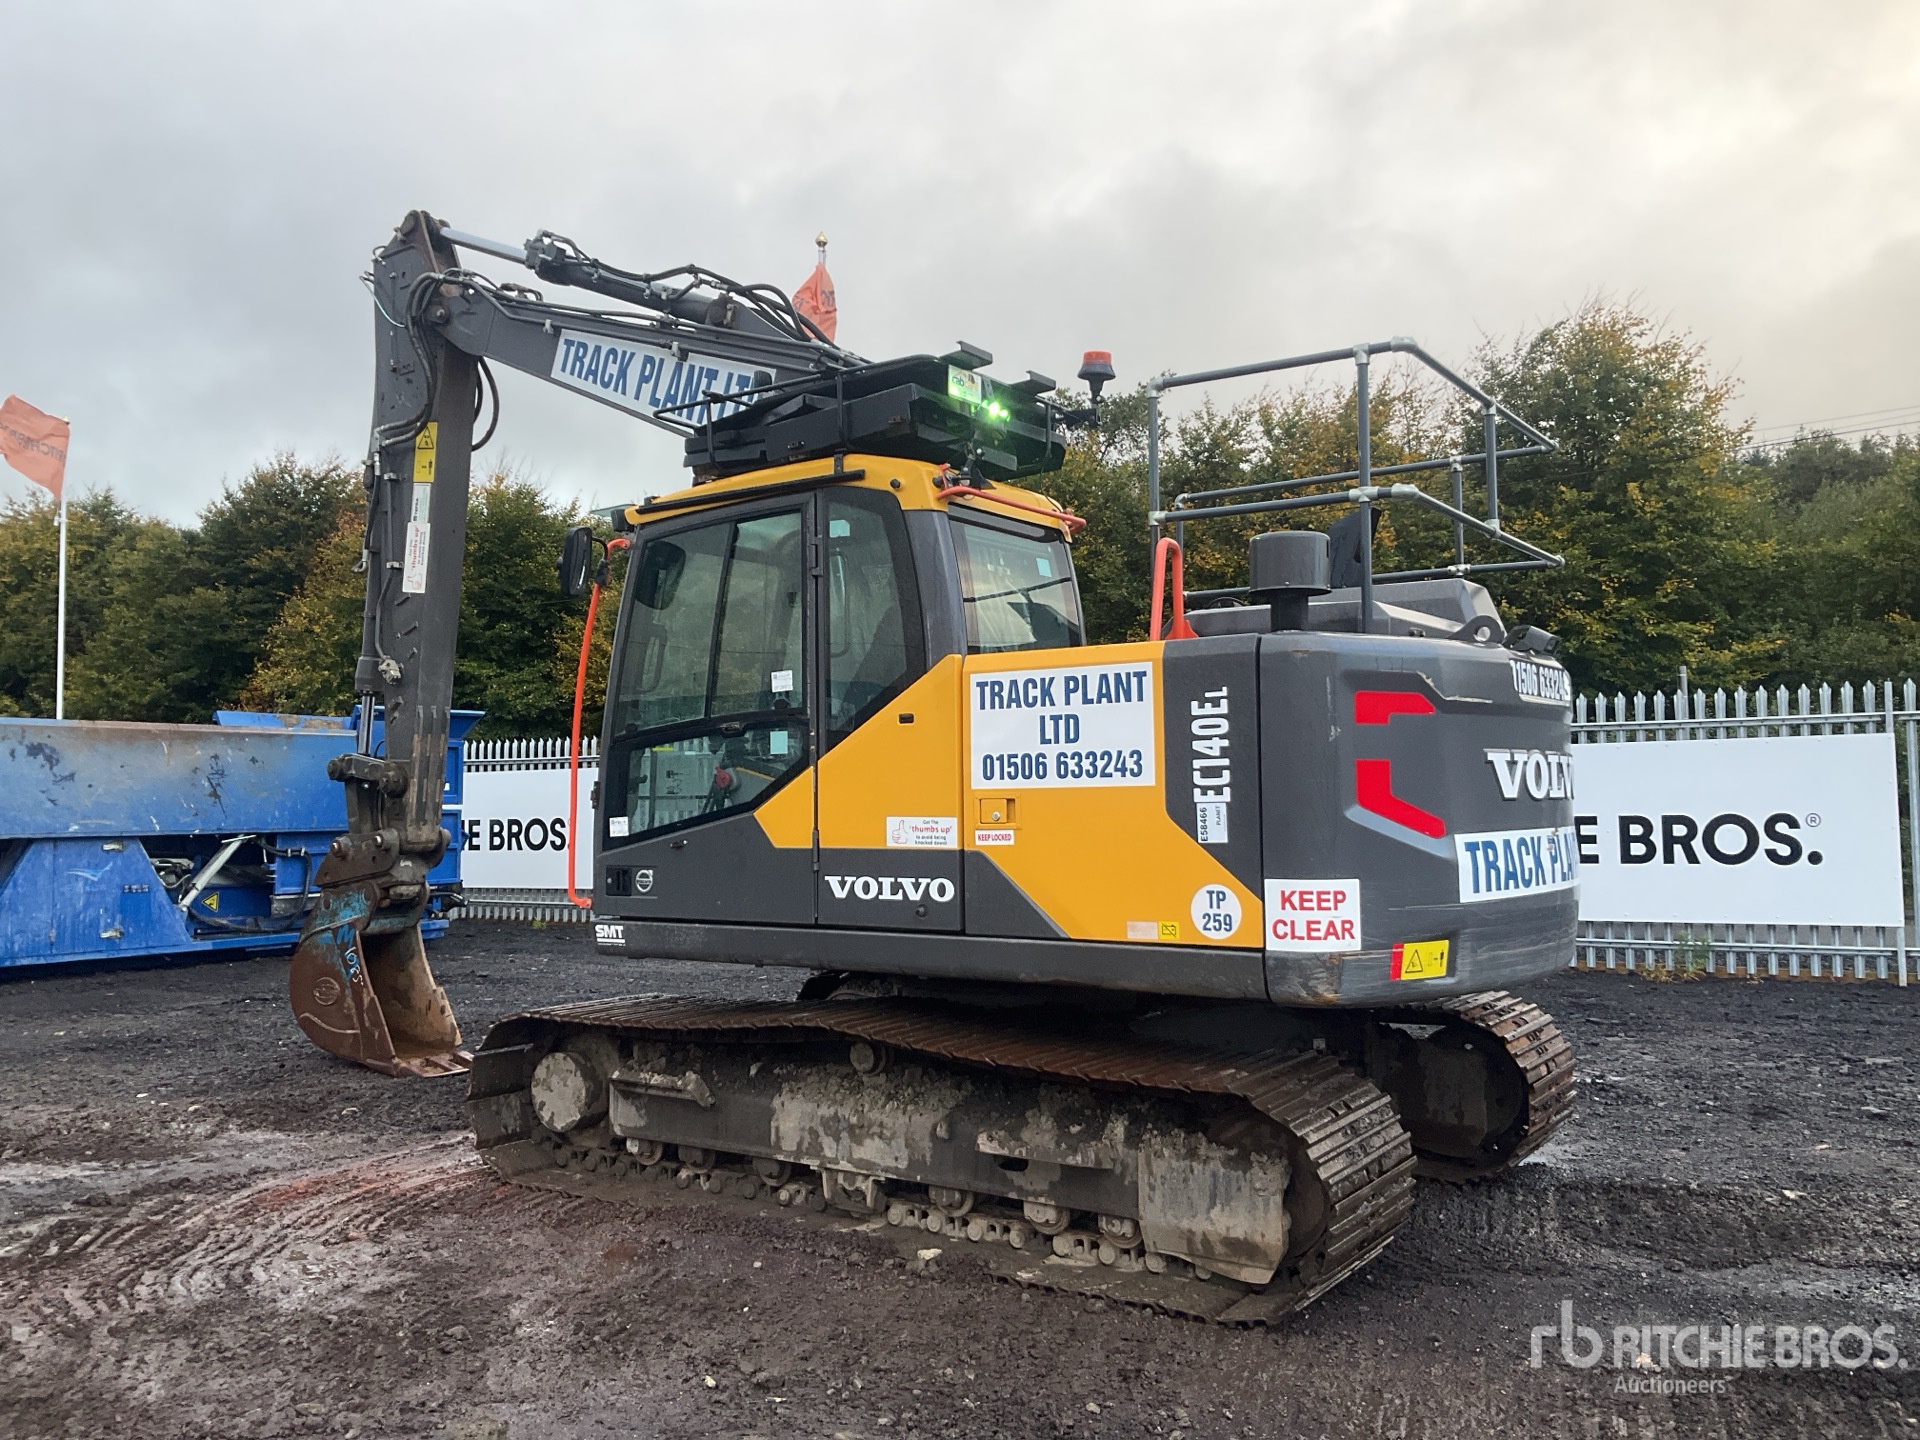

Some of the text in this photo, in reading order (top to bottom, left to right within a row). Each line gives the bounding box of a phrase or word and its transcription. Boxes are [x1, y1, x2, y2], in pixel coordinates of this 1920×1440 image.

[561, 338, 636, 396] TRACK
[634, 354, 719, 425] PLANT
[976, 670, 1147, 711] TRACK PLANT
[1039, 713, 1080, 745] LTD
[1190, 686, 1232, 803] EC140EL
[982, 749, 1143, 781] 01506 633243
[1484, 749, 1575, 801] VOLV
[489, 817, 569, 851] BROS
[977, 833, 1012, 842] KEEP LOCKED
[1199, 806, 1209, 842] E58466
[1464, 831, 1579, 894] TRACK PLA
[824, 875, 955, 902] VOLVO
[1206, 889, 1227, 910] TP
[1280, 890, 1347, 911] KEEP
[595, 925, 624, 938] SMT
[1202, 912, 1233, 933] 259
[1271, 919, 1355, 941] CLEAR
